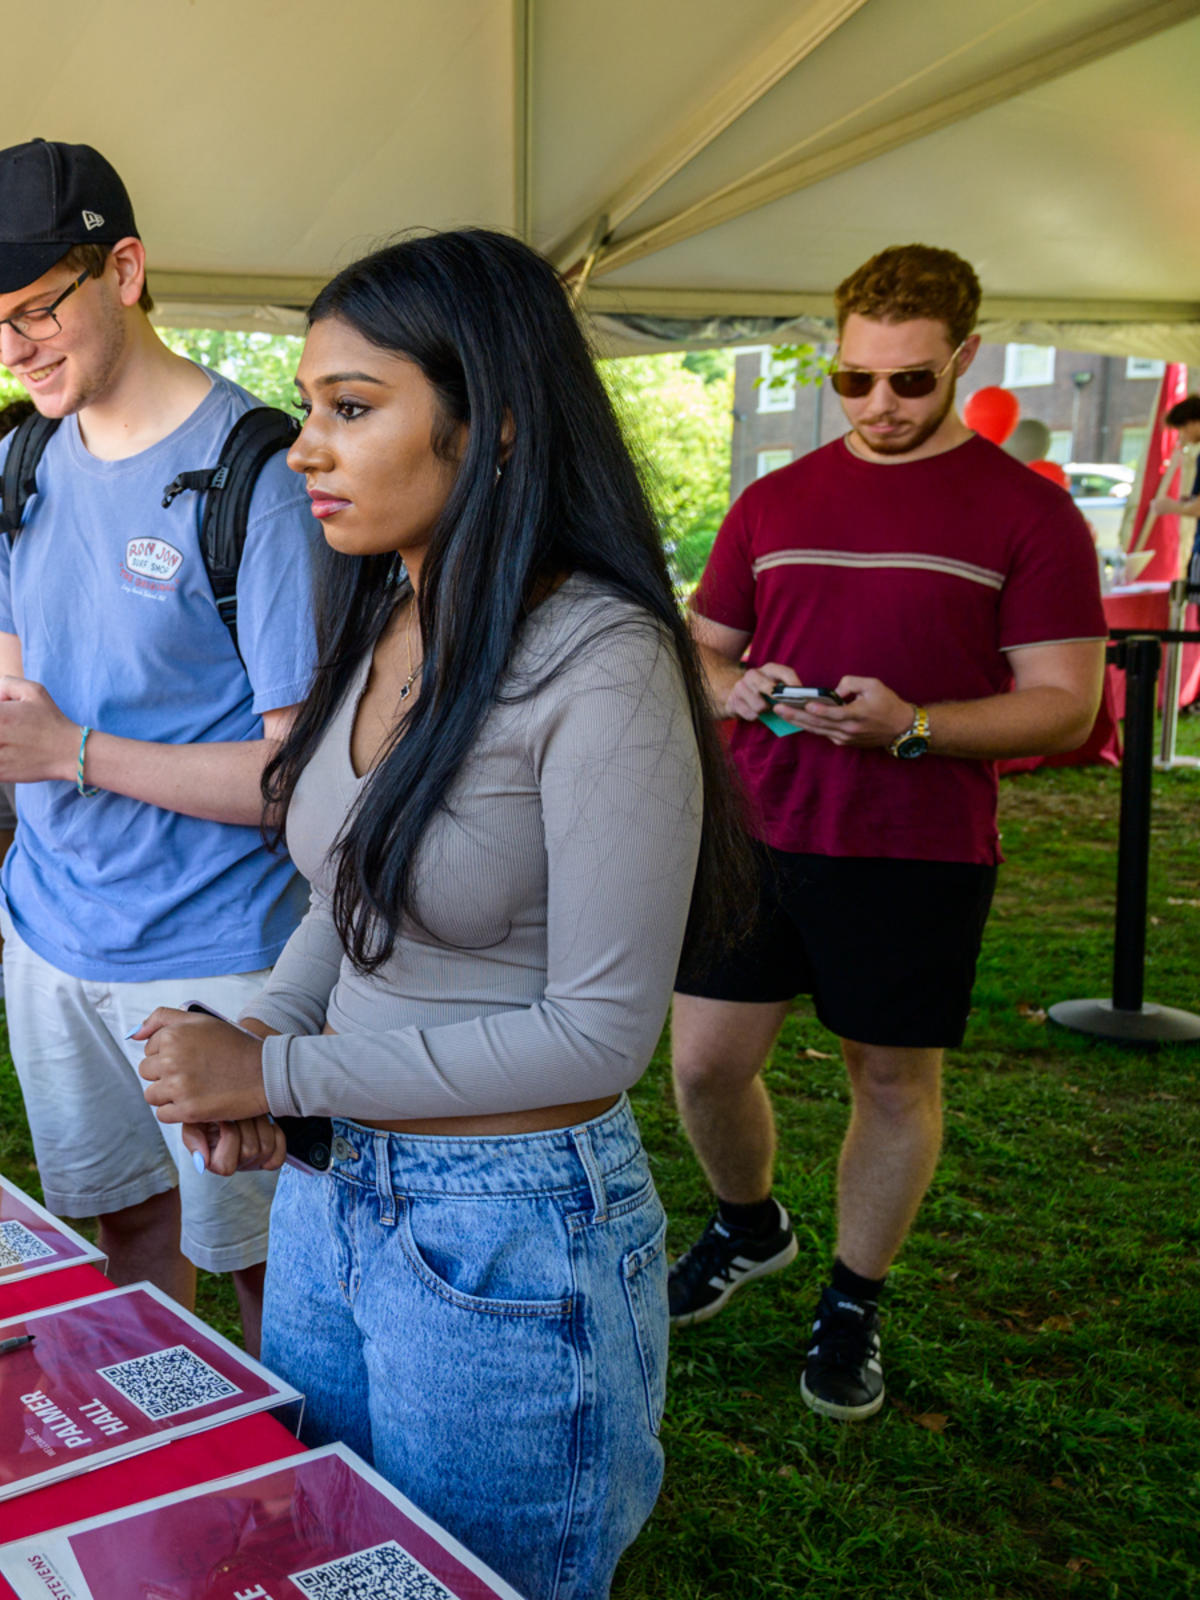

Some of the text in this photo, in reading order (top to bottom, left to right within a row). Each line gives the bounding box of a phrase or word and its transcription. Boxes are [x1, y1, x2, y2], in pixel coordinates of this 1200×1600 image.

[20, 1390, 92, 1449] PALMER
[79, 1397, 129, 1436] HALL
[27, 1554, 72, 1600] STEVENS
